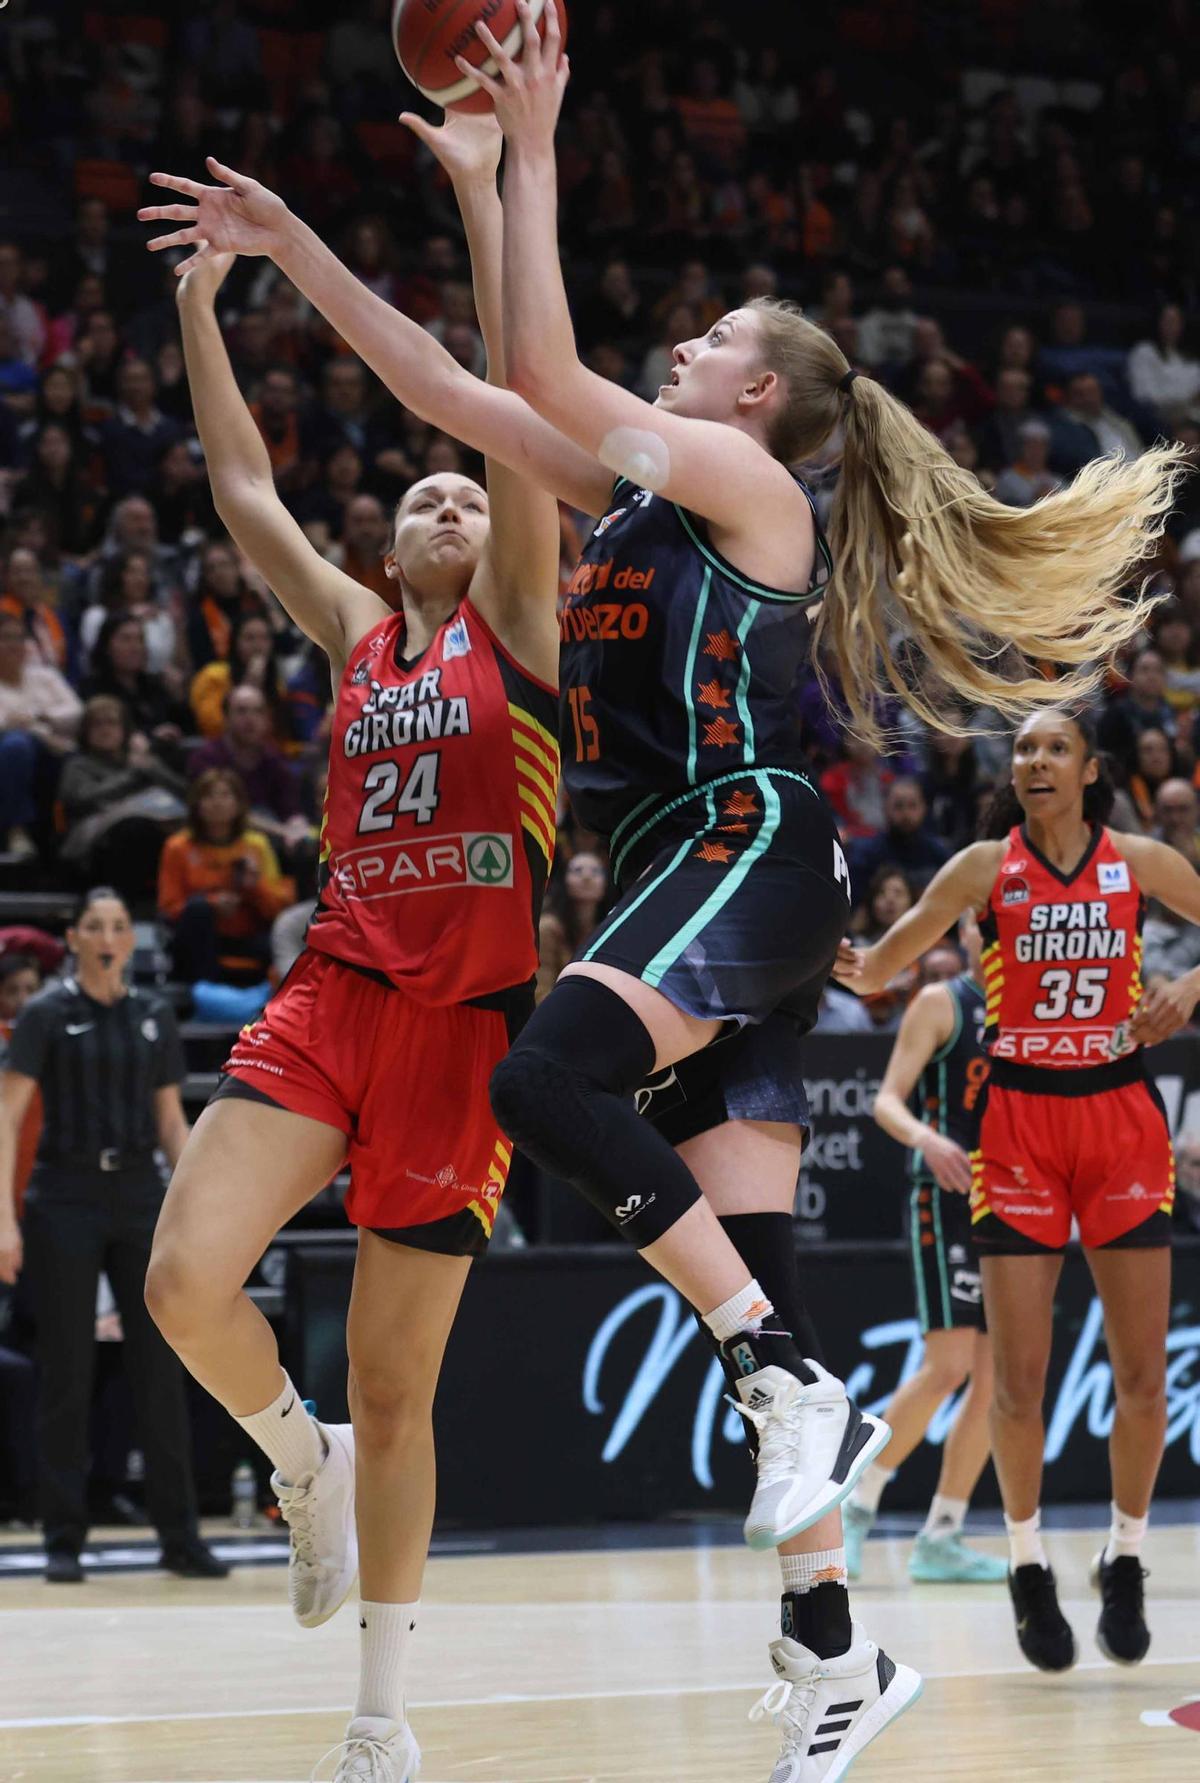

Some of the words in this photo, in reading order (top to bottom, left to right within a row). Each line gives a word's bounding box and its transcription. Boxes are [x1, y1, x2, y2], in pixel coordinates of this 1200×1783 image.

[613, 565, 656, 590] del
[362, 668, 441, 714] SPAR
[344, 696, 471, 757] GIRONA
[357, 751, 440, 834] 24
[1029, 901, 1109, 931] SPAR
[1014, 929, 1127, 963] GIRONA
[1032, 967, 1110, 1021] 35
[993, 1034, 1111, 1059] SPAR
[803, 1067, 882, 1118] ncia
